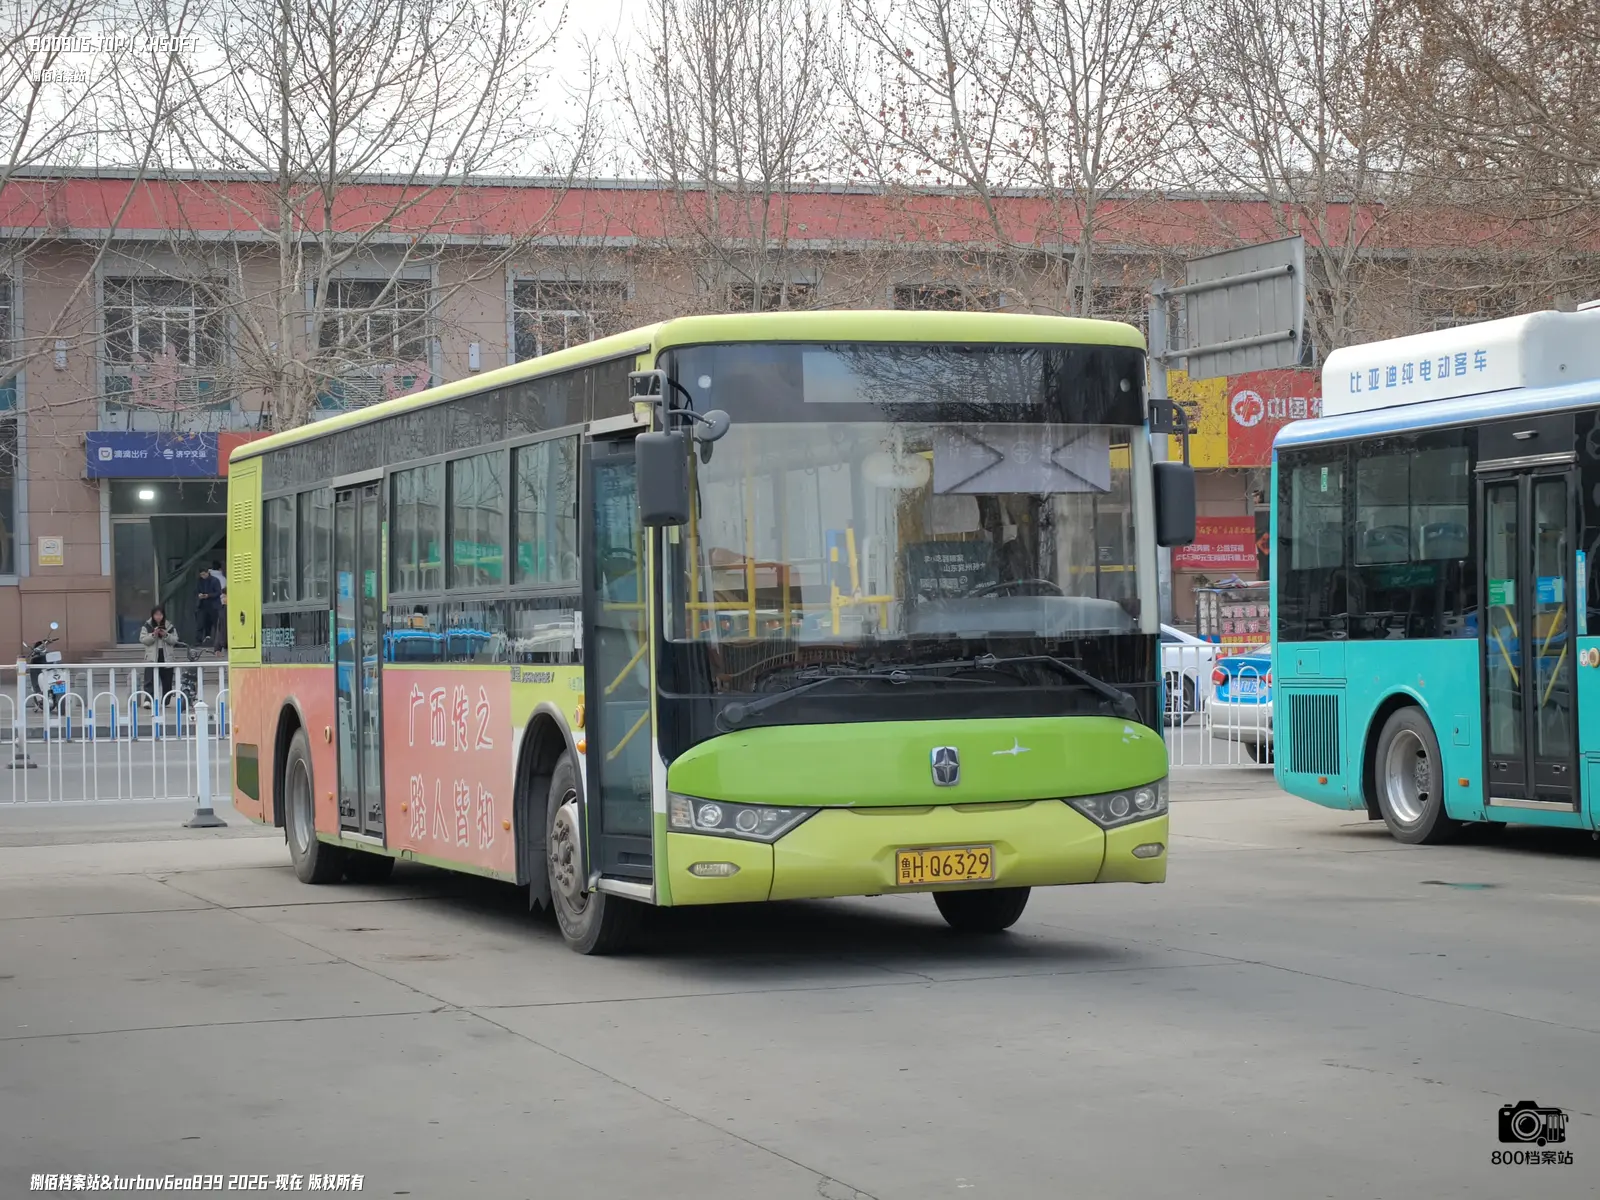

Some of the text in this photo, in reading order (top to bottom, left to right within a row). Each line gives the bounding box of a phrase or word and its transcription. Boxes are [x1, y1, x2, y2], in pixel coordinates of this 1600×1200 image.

[1350, 349, 1487, 393] 比亚迪纯电动客车
[114, 449, 148, 459] 滴滴出行
[409, 773, 495, 850] 路人皆知
